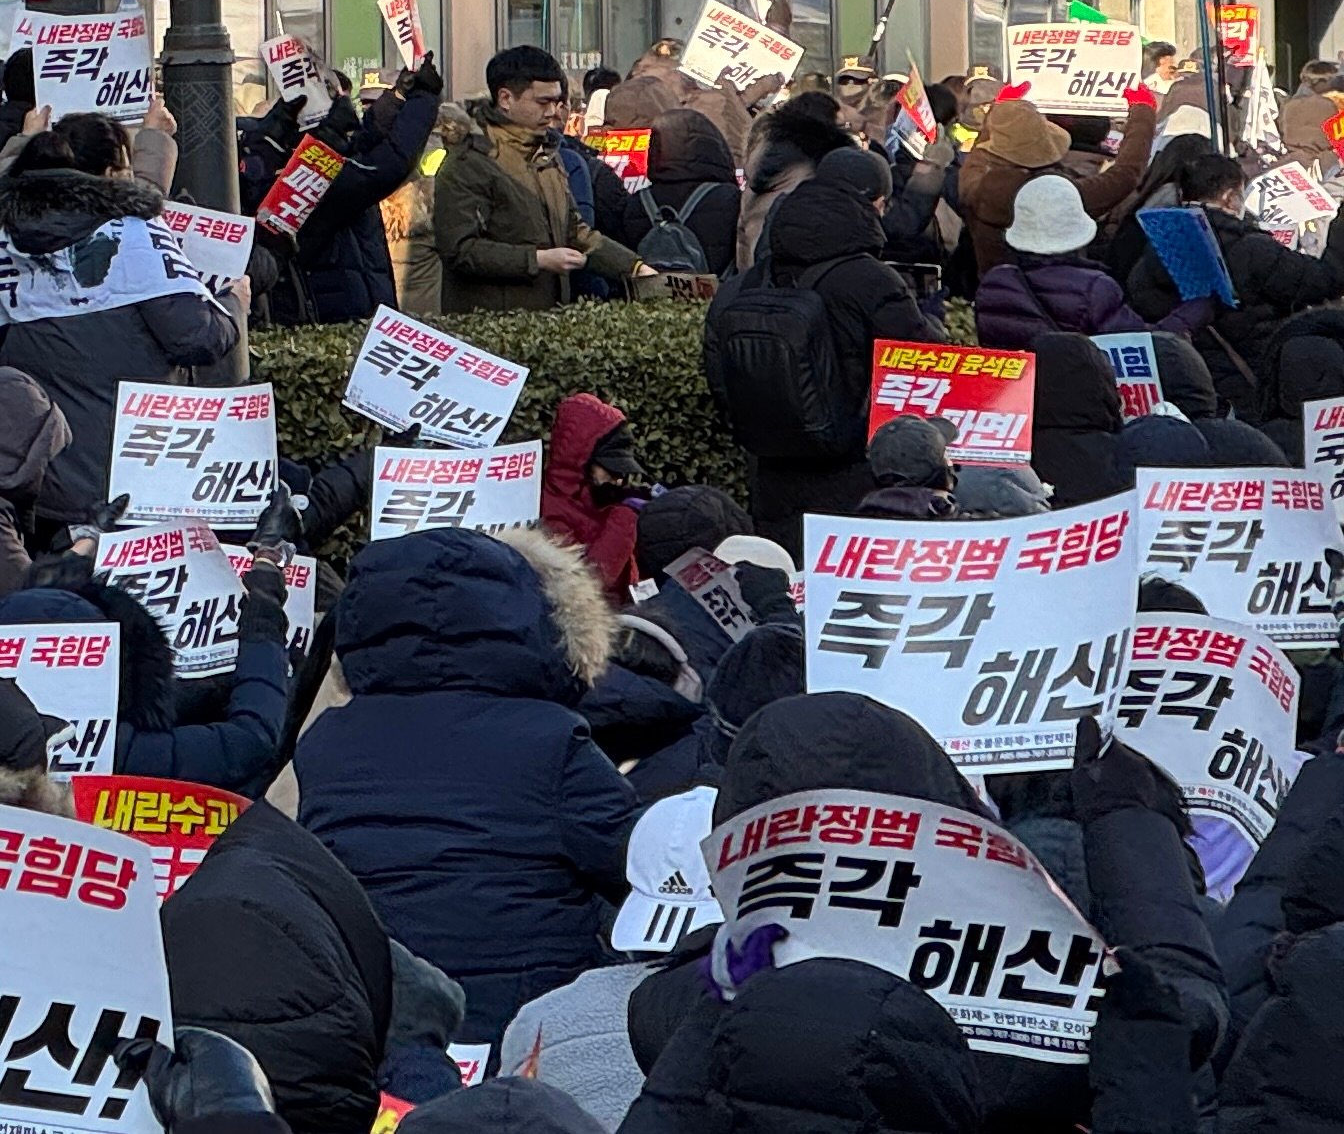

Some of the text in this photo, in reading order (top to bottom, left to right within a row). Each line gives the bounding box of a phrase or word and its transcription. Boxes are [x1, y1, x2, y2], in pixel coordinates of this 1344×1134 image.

[37, 22, 115, 44] 내란정범
[698, 24, 751, 60] 즉각
[1013, 30, 1134, 46] 내란정범 국힘당
[40, 46, 109, 83] 즉각
[1016, 48, 1077, 73] 즉각
[194, 216, 248, 243] 국힘당
[364, 339, 441, 391] 즉각
[375, 316, 520, 387] 내란정범 국힘당
[879, 347, 1028, 380] 내란수괴 윤석열
[121, 392, 271, 422] 내란정범 국힘당
[876, 374, 951, 414] 즉각
[409, 392, 504, 439] 해산!
[120, 424, 215, 469] 즉각
[379, 451, 537, 484] 내란정범 국힘당
[378, 489, 476, 532] 즉각
[1144, 479, 1325, 511] 내란정범 국힘당
[101, 530, 185, 569] 내란정범
[813, 511, 1130, 582] 내란정범 국힘당
[1147, 519, 1265, 573] 즉각
[817, 591, 996, 669] 즉각
[30, 635, 111, 668] 국힘당
[962, 628, 1130, 726] 해산!
[717, 804, 922, 873] 내란정범
[658, 886, 693, 894] adidas
[737, 852, 922, 928] 즉각
